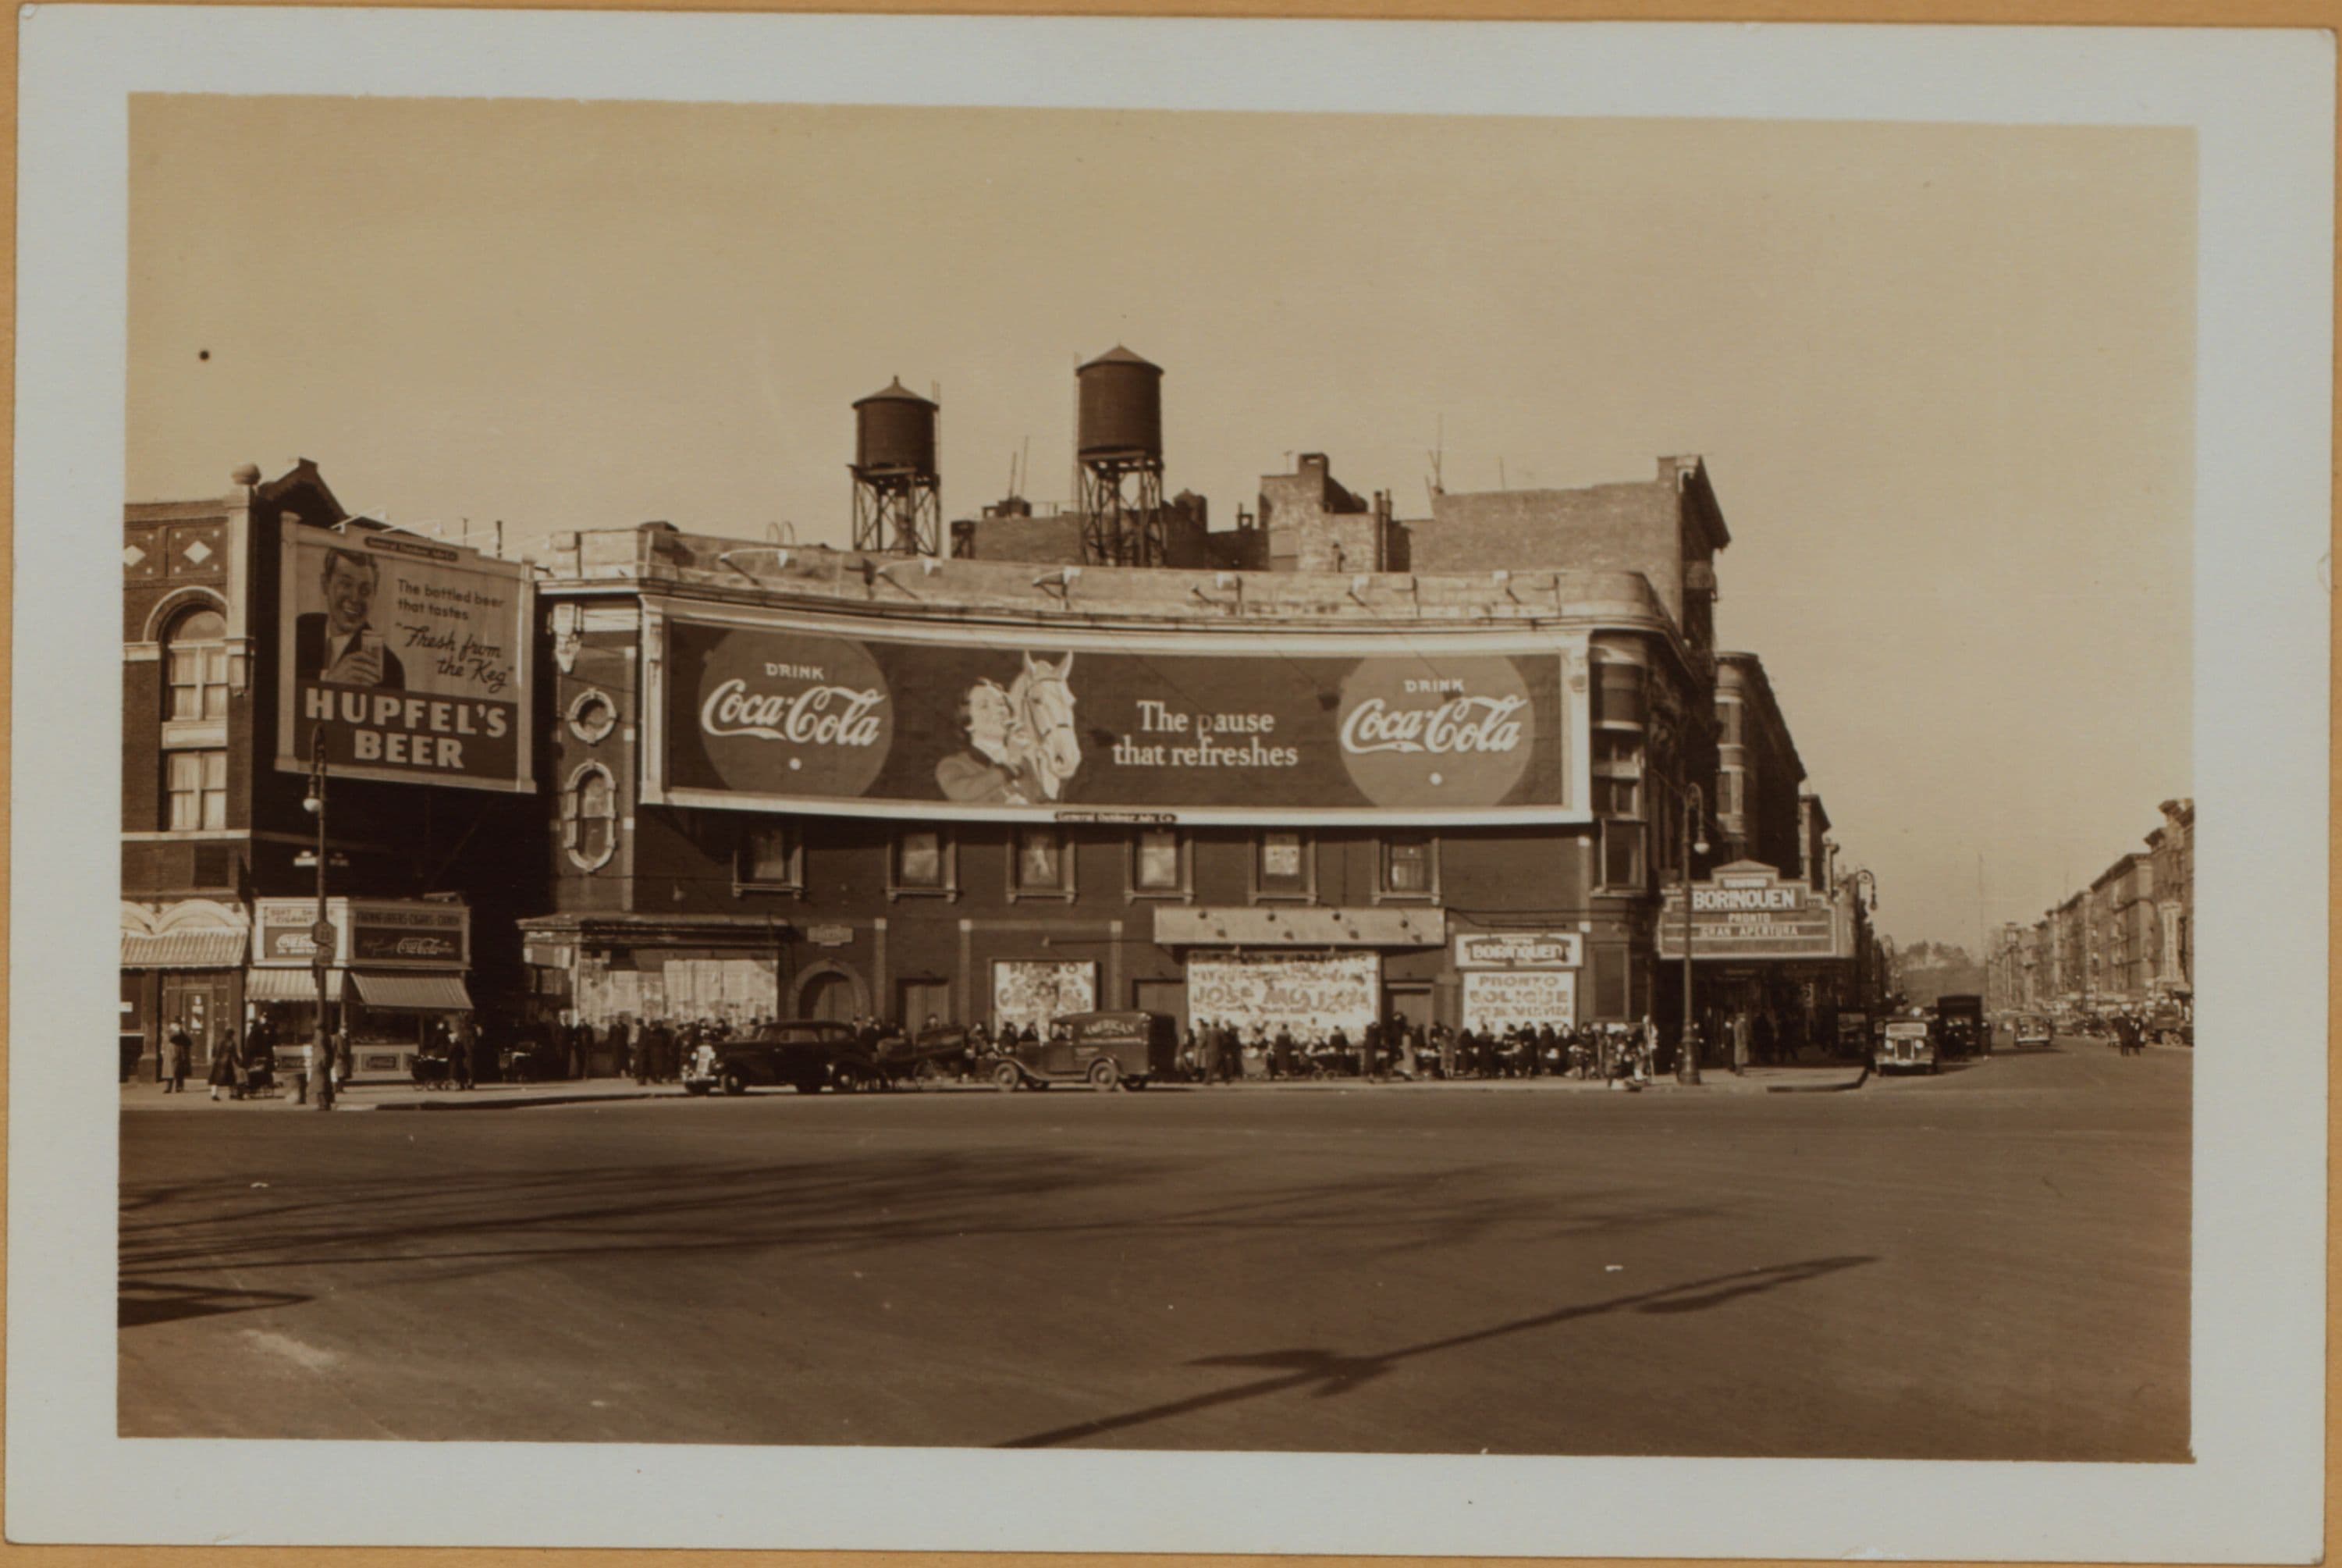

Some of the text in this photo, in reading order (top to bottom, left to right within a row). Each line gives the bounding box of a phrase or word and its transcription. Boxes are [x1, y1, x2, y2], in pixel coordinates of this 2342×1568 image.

[397, 578, 506, 609] The bottled beer
[397, 598, 469, 621] that tastes
[458, 631, 503, 663] from
[436, 656, 464, 677] the
[765, 662, 824, 681] DRINK
[1403, 678, 1465, 693] DRINK
[304, 687, 507, 738] HUPFEL'S
[701, 677, 887, 747] Coca-Cola
[1136, 700, 1275, 741] The pause
[1339, 695, 1528, 754] Coca-Cola
[354, 729, 465, 769] BEER
[1112, 734, 1299, 766] that refreshes
